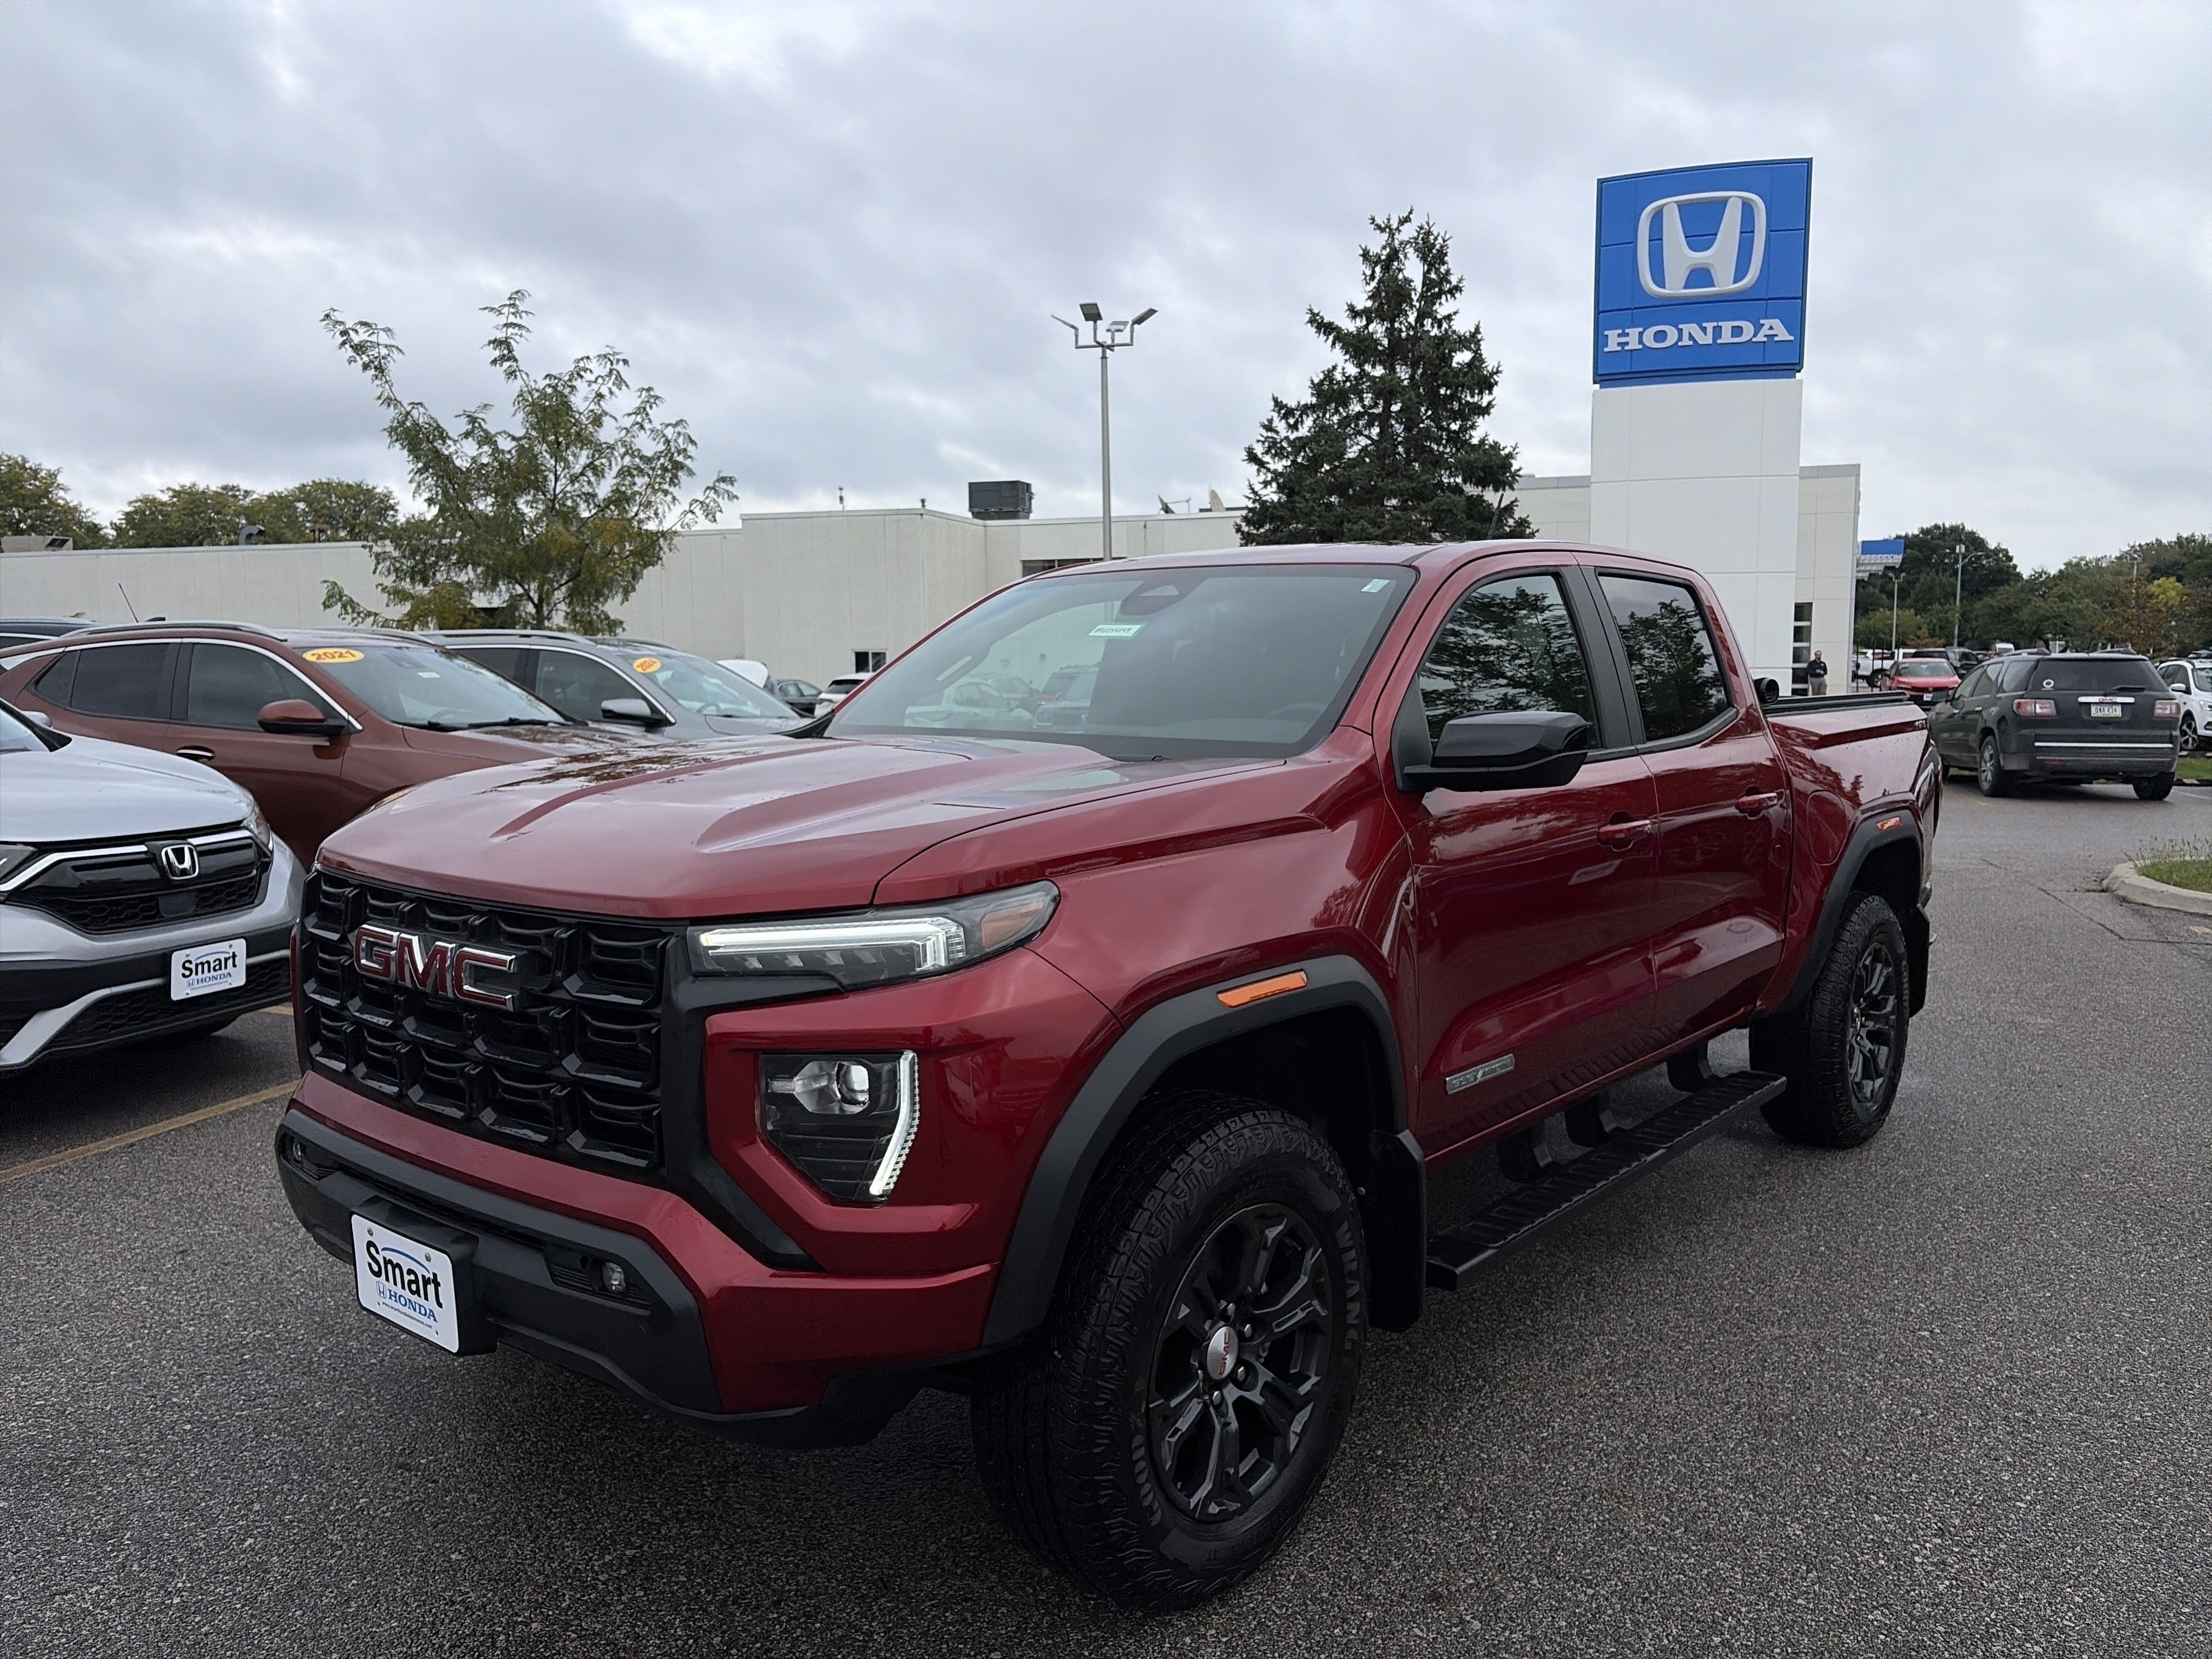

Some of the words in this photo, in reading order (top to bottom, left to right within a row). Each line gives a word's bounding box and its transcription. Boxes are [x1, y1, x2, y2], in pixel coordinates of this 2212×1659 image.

[1604, 319, 1795, 352] HONDA
[181, 951, 238, 978] Smart
[196, 972, 232, 985] HONDA
[354, 924, 516, 1012] GMC
[366, 1240, 443, 1309] Smart
[388, 1289, 438, 1323] HONDA
[1219, 1331, 1229, 1375] GMC
